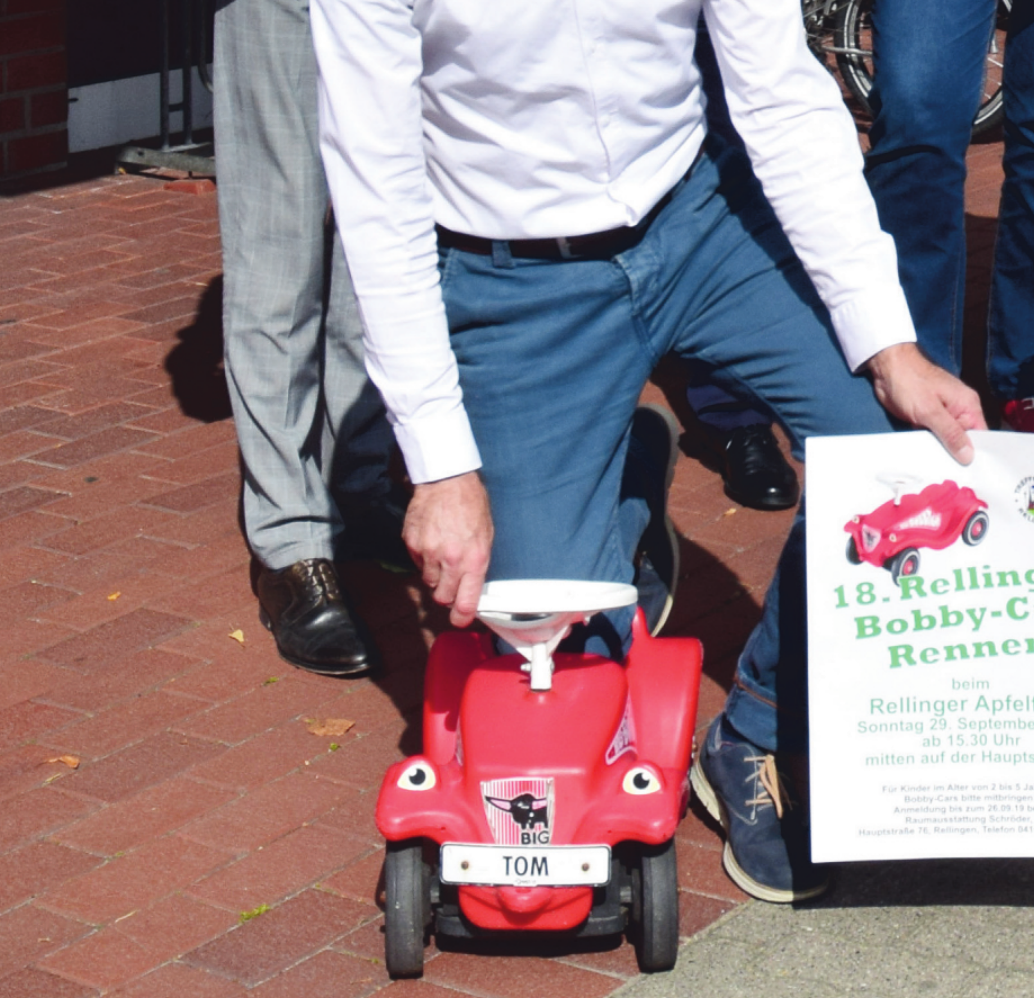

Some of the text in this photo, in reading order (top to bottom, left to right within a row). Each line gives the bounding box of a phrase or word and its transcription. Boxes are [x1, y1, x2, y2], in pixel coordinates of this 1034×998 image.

[833, 581, 891, 609] 18.
[951, 677, 990, 690] beim
[869, 695, 968, 717] Rellinger
[857, 720, 923, 734] Sonntag
[929, 718, 952, 730] 29.
[922, 733, 1022, 747] ab 15.30 Uhr
[865, 752, 915, 765] mitten
[920, 751, 946, 764] auf
[950, 750, 976, 763] der
[881, 785, 897, 793] Für
[900, 784, 931, 792] Kinder
[991, 783, 996, 791] 2
[999, 783, 1013, 791] bis
[1015, 783, 1021, 791] 5
[904, 794, 1033, 804] Bobby-Cars bitte mitbringen
[893, 806, 946, 815] Anmeldung
[949, 805, 962, 813] bis
[905, 815, 987, 825] Raumausstattung
[521, 830, 549, 845] BIG
[858, 826, 915, 836] Hauptstraße
[982, 825, 1015, 833] Telefon
[502, 855, 549, 876] TOM
